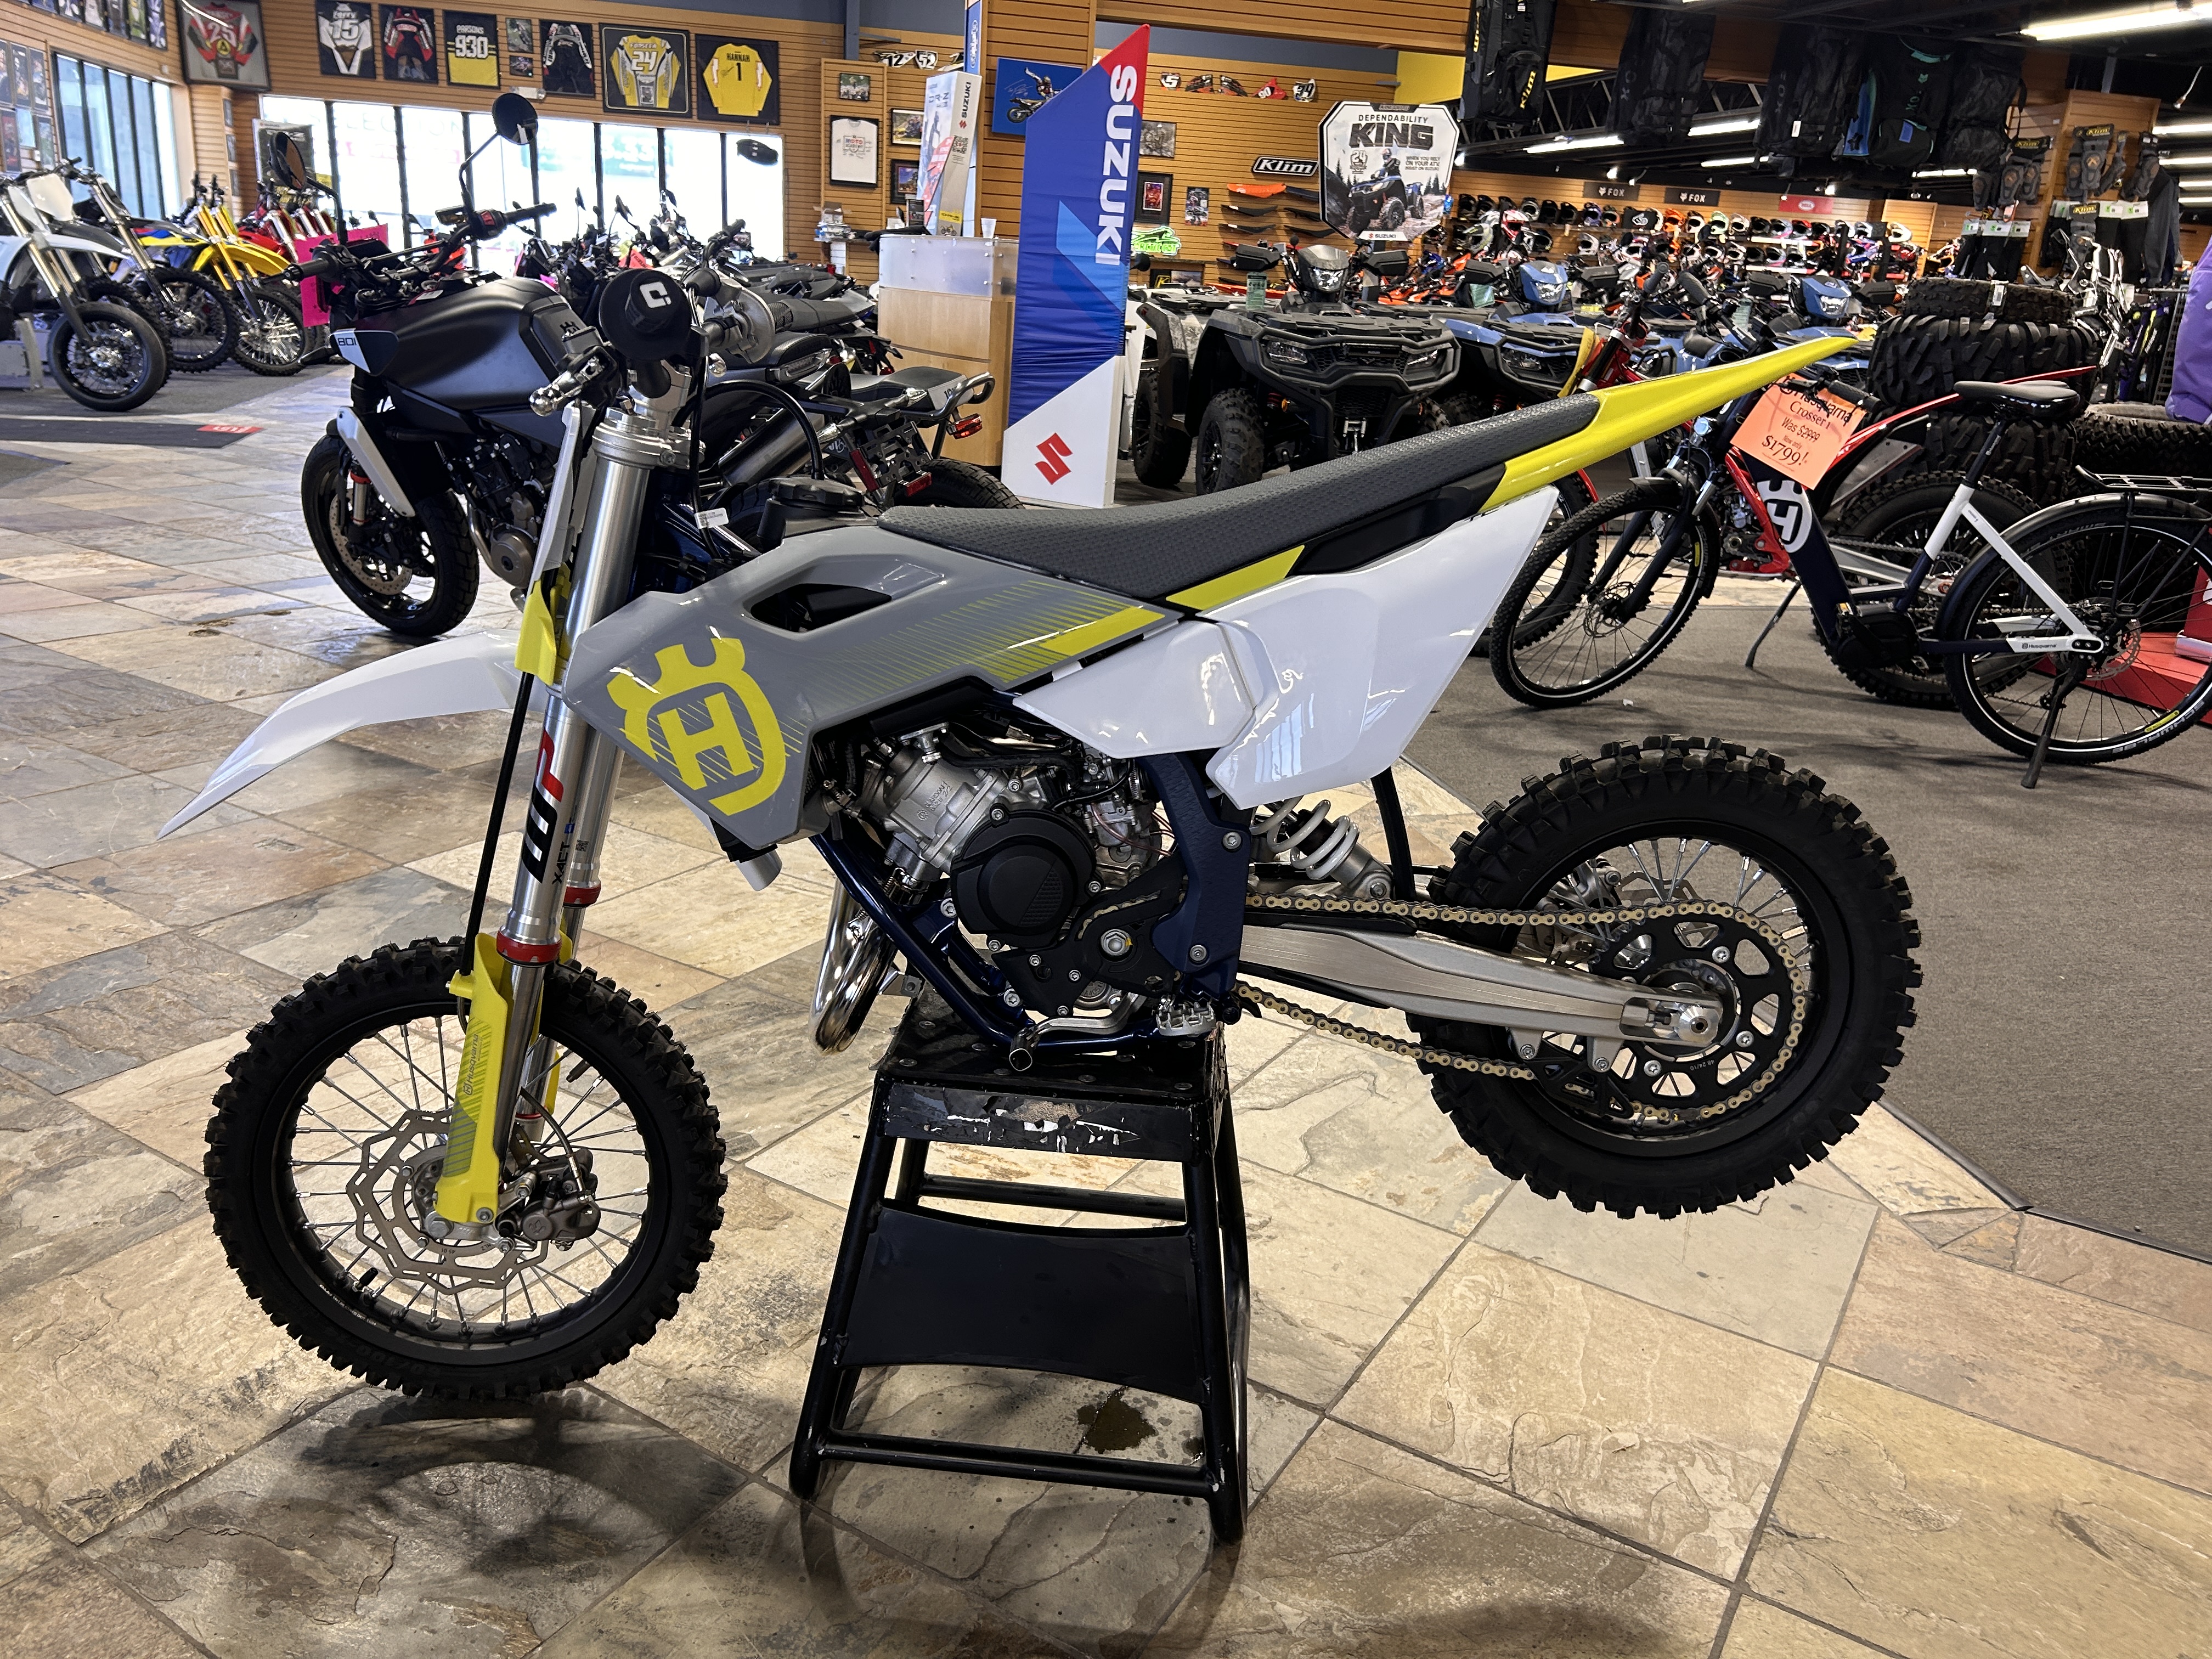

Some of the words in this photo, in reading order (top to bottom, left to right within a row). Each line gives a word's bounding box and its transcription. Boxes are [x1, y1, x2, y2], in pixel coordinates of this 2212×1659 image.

[208, 22, 236, 47] 25
[330, 19, 359, 40] 15
[455, 35, 488, 59] 930
[726, 53, 750, 62] HANNAH
[631, 50, 658, 72] 24
[736, 62, 742, 81] 1
[962, 81, 972, 119] SUZUKI
[1520, 70, 1536, 110] Klim
[1358, 114, 1429, 123] DEPENDABILITY
[1349, 122, 1434, 151] KING
[1095, 64, 1138, 266] SUZUKI
[1257, 159, 1313, 173] Klim
[1607, 188, 1625, 197] FOX
[1688, 194, 1706, 203] FOX
[1781, 416, 1798, 432] Was
[1790, 400, 1826, 426] Crosser
[552, 840, 571, 885] XACT
[466, 1034, 479, 1084] Husqvarna
[1690, 1062, 1706, 1071] 24/10
